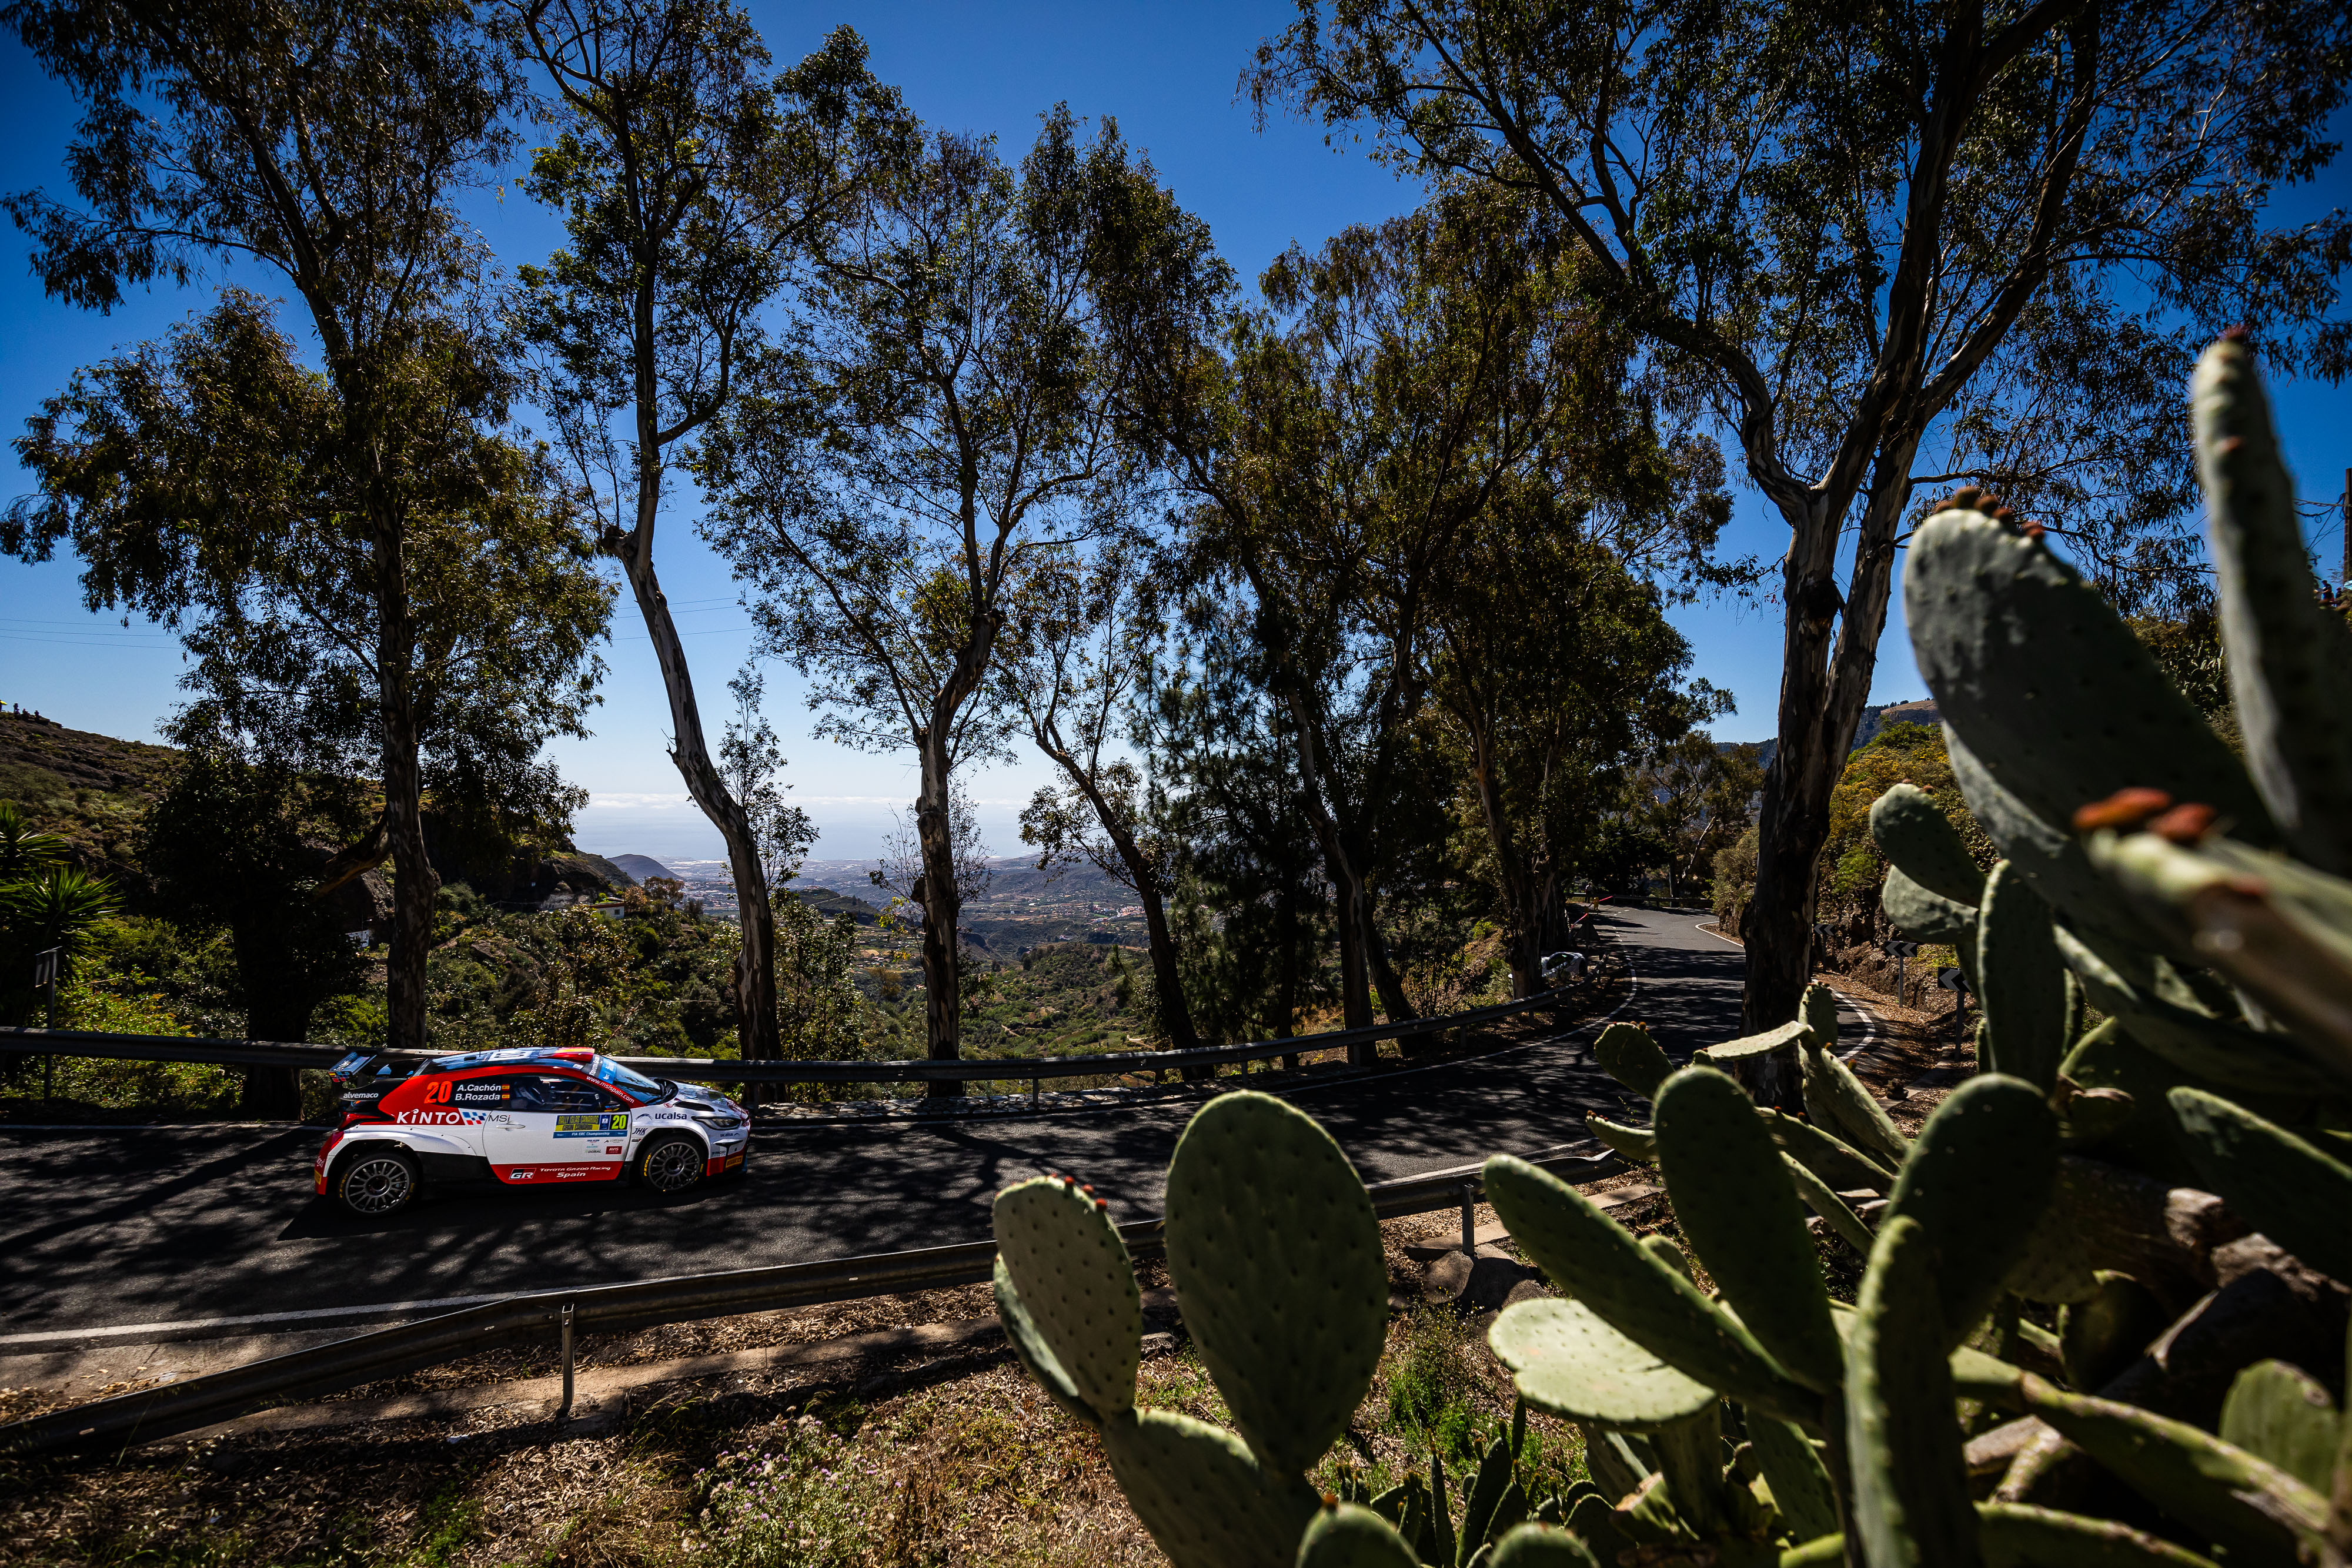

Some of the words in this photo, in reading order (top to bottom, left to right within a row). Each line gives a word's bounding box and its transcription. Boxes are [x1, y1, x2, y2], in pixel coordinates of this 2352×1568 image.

[424, 1081, 452, 1104] 20
[586, 1076, 634, 1104] www.msispain.com
[558, 1116, 569, 1124] RALLY
[580, 1115, 599, 1124] CANARIAS
[612, 1115, 627, 1129] 20
